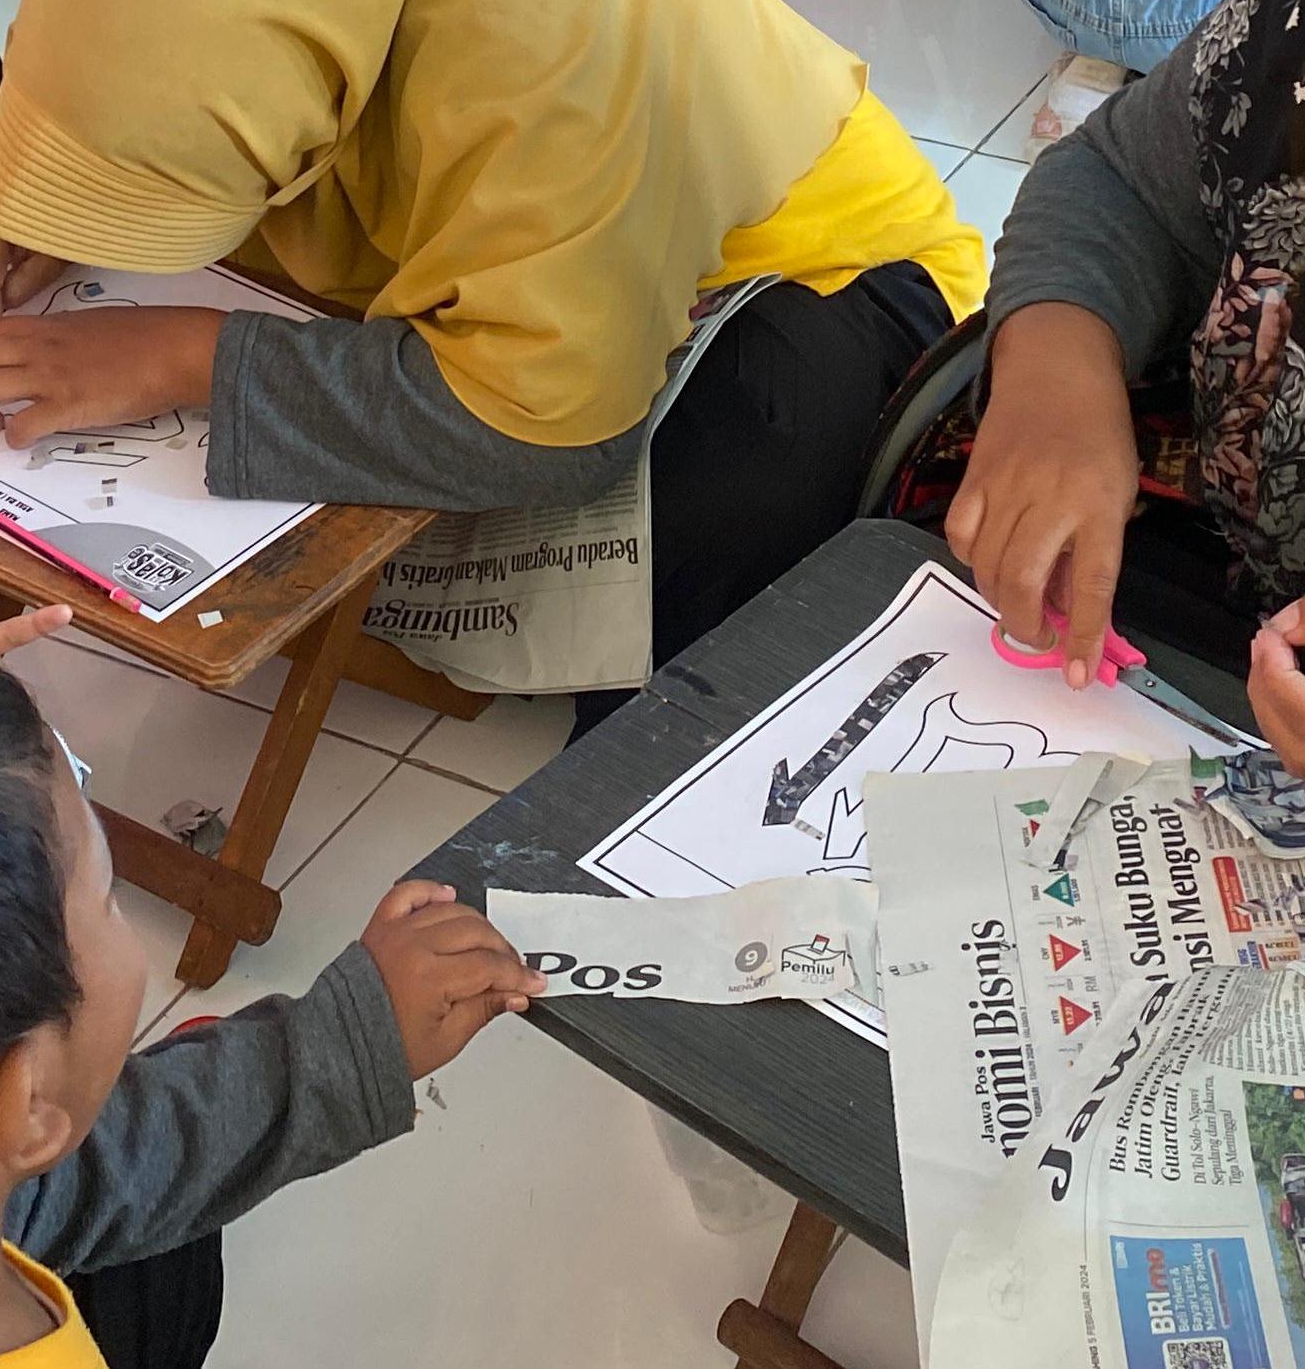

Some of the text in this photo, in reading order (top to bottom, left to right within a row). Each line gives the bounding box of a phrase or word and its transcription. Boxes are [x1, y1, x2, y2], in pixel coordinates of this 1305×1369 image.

[126, 544, 190, 590] Kolase
[455, 556, 508, 582] Makan
[511, 541, 574, 574] Program
[577, 537, 639, 569] Beradu
[400, 563, 454, 590] Gratis
[1109, 795, 1150, 888] Bunga,
[1149, 803, 1205, 926] Menguat
[1124, 892, 1167, 967] Suku
[523, 951, 663, 991] Pos
[781, 960, 835, 975] Pemilu
[1173, 932, 1215, 973] nsi
[960, 919, 1021, 1039] Bisnis
[1116, 1026, 1181, 1130] Rombongan
[975, 1065, 995, 1144] Jawa Pos
[1160, 1082, 1181, 1182] Guardrail,
[1205, 1116, 1218, 1137] dari
[1109, 1135, 1128, 1172] Bus
[1134, 1123, 1152, 1179] Jatim
[1190, 1153, 1204, 1170] Tol
[1208, 1139, 1226, 1186] Sepulang
[1220, 1109, 1244, 1186] Tiga Meninggal
[1194, 1172, 1207, 1184] Di
[1080, 1265, 1090, 1288] 2024
[1195, 1242, 1207, 1282] Praktis
[1082, 1291, 1095, 1336] FEBRUARI
[1172, 1280, 1185, 1310] Token
[1182, 1264, 1203, 1331] Bayar Listrik
[1202, 1292, 1217, 1331] Mudah
[1175, 1312, 1190, 1332] Beli
